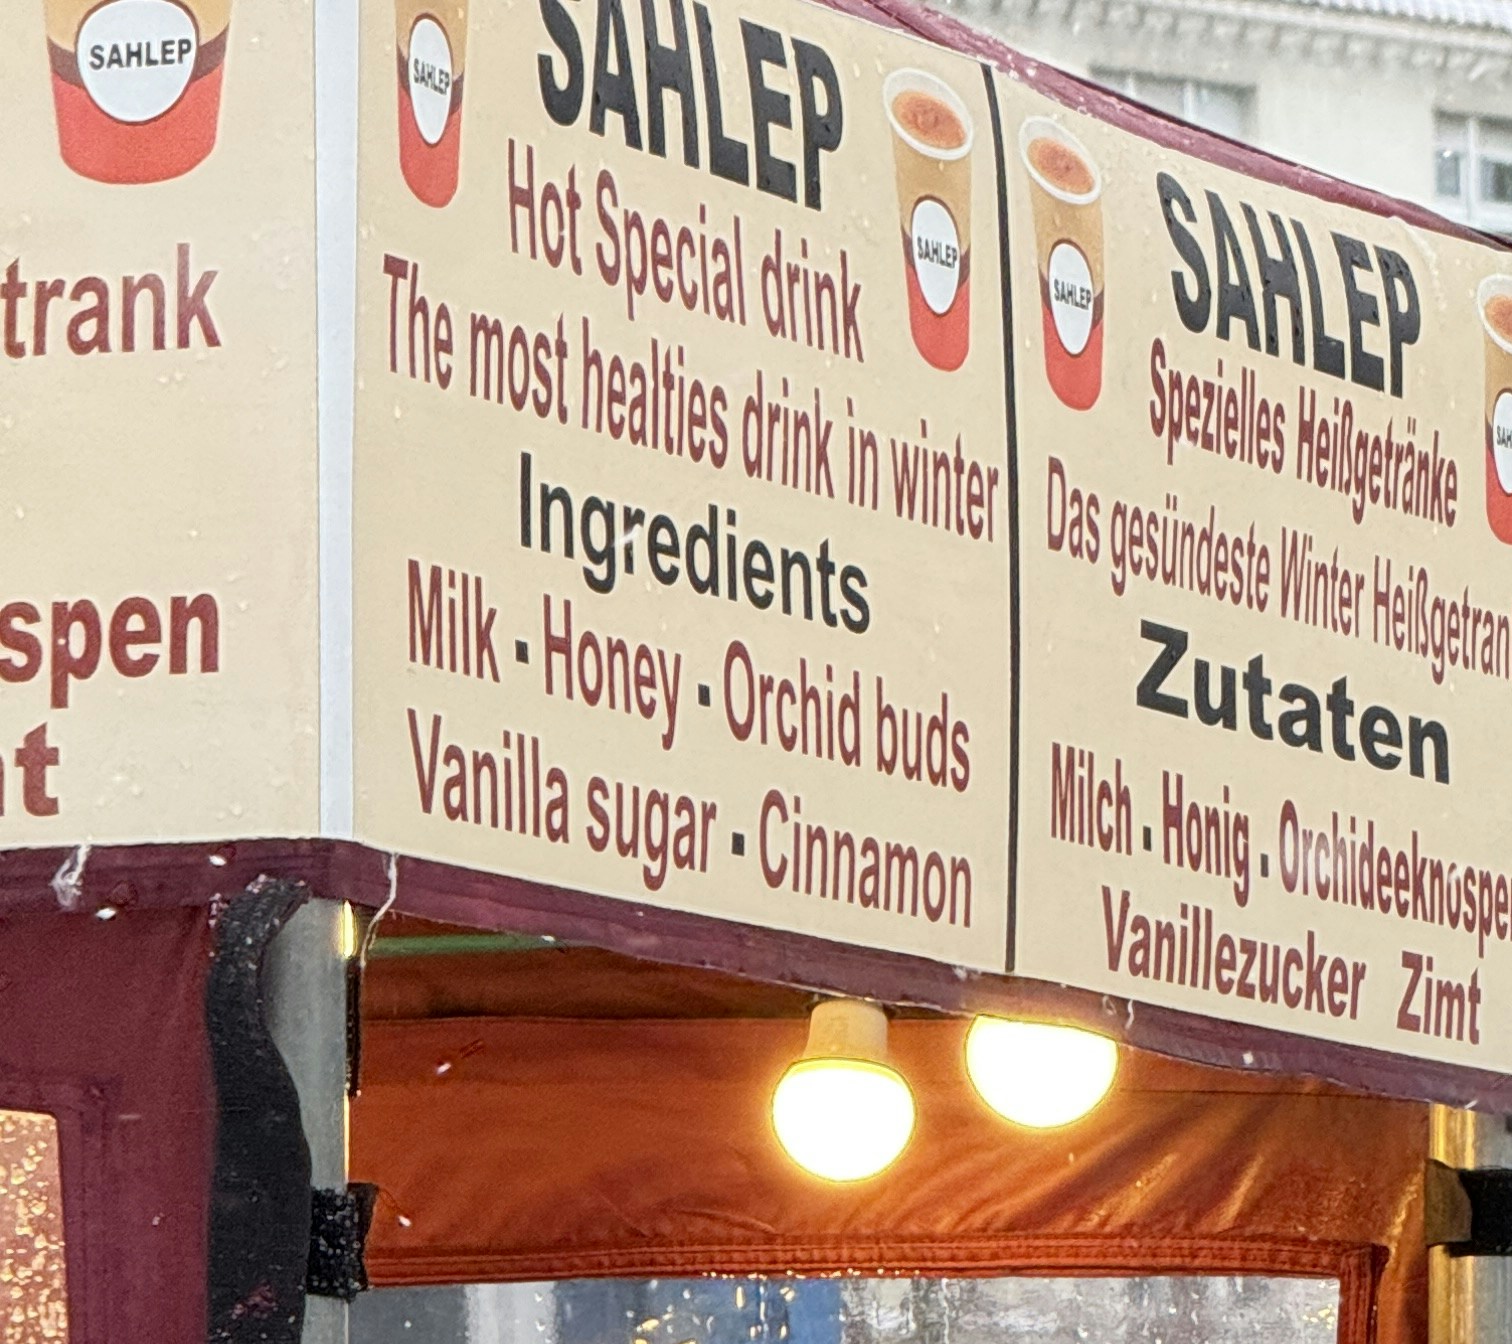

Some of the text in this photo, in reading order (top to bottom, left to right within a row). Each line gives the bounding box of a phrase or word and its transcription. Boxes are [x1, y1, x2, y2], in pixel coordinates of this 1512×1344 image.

[89, 38, 192, 70] SAHLEP
[538, 0, 844, 211] SAHLEP
[0, 244, 221, 359] trank
[508, 138, 864, 363] Hot Special drink
[917, 236, 958, 269] SAHLEP
[1054, 278, 1092, 311] SAHLEP
[1157, 172, 1420, 399] SAHLEP
[383, 254, 998, 542] The most healties drink in winter
[1150, 338, 1457, 527] Spezielles Heißgetränke
[520, 452, 870, 634] Ingredients
[1048, 456, 1100, 564] Das
[1111, 493, 1270, 612] gesündeste
[1281, 527, 1364, 637] Winter
[0, 594, 219, 709] spen
[408, 559, 969, 792] Milk Honey Orchid buds
[1137, 619, 1449, 785] Zutaten
[407, 708, 971, 928] Vanilla sugar Cinnamon
[1051, 742, 1132, 856] Milch
[1163, 771, 1249, 908] Honig
[1102, 885, 1481, 1045] Vanillezucker Zimt
